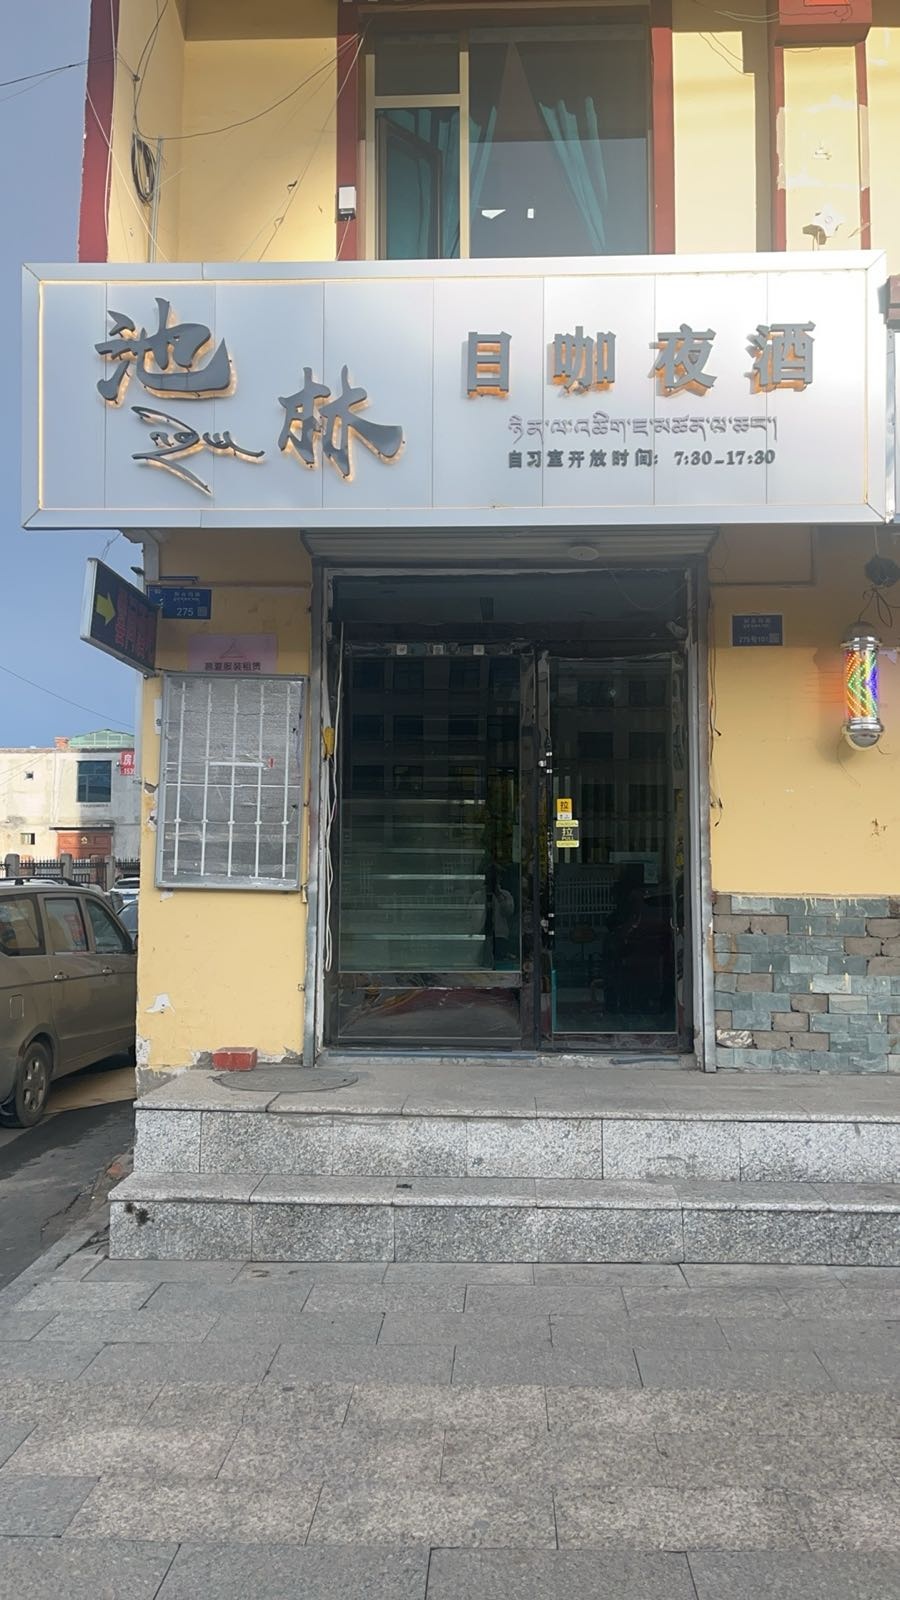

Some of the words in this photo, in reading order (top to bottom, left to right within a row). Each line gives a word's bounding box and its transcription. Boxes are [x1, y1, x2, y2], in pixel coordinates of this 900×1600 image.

[176, 607, 194, 617] 275
[560, 801, 569, 809] 拉
[562, 827, 573, 836] 拉
